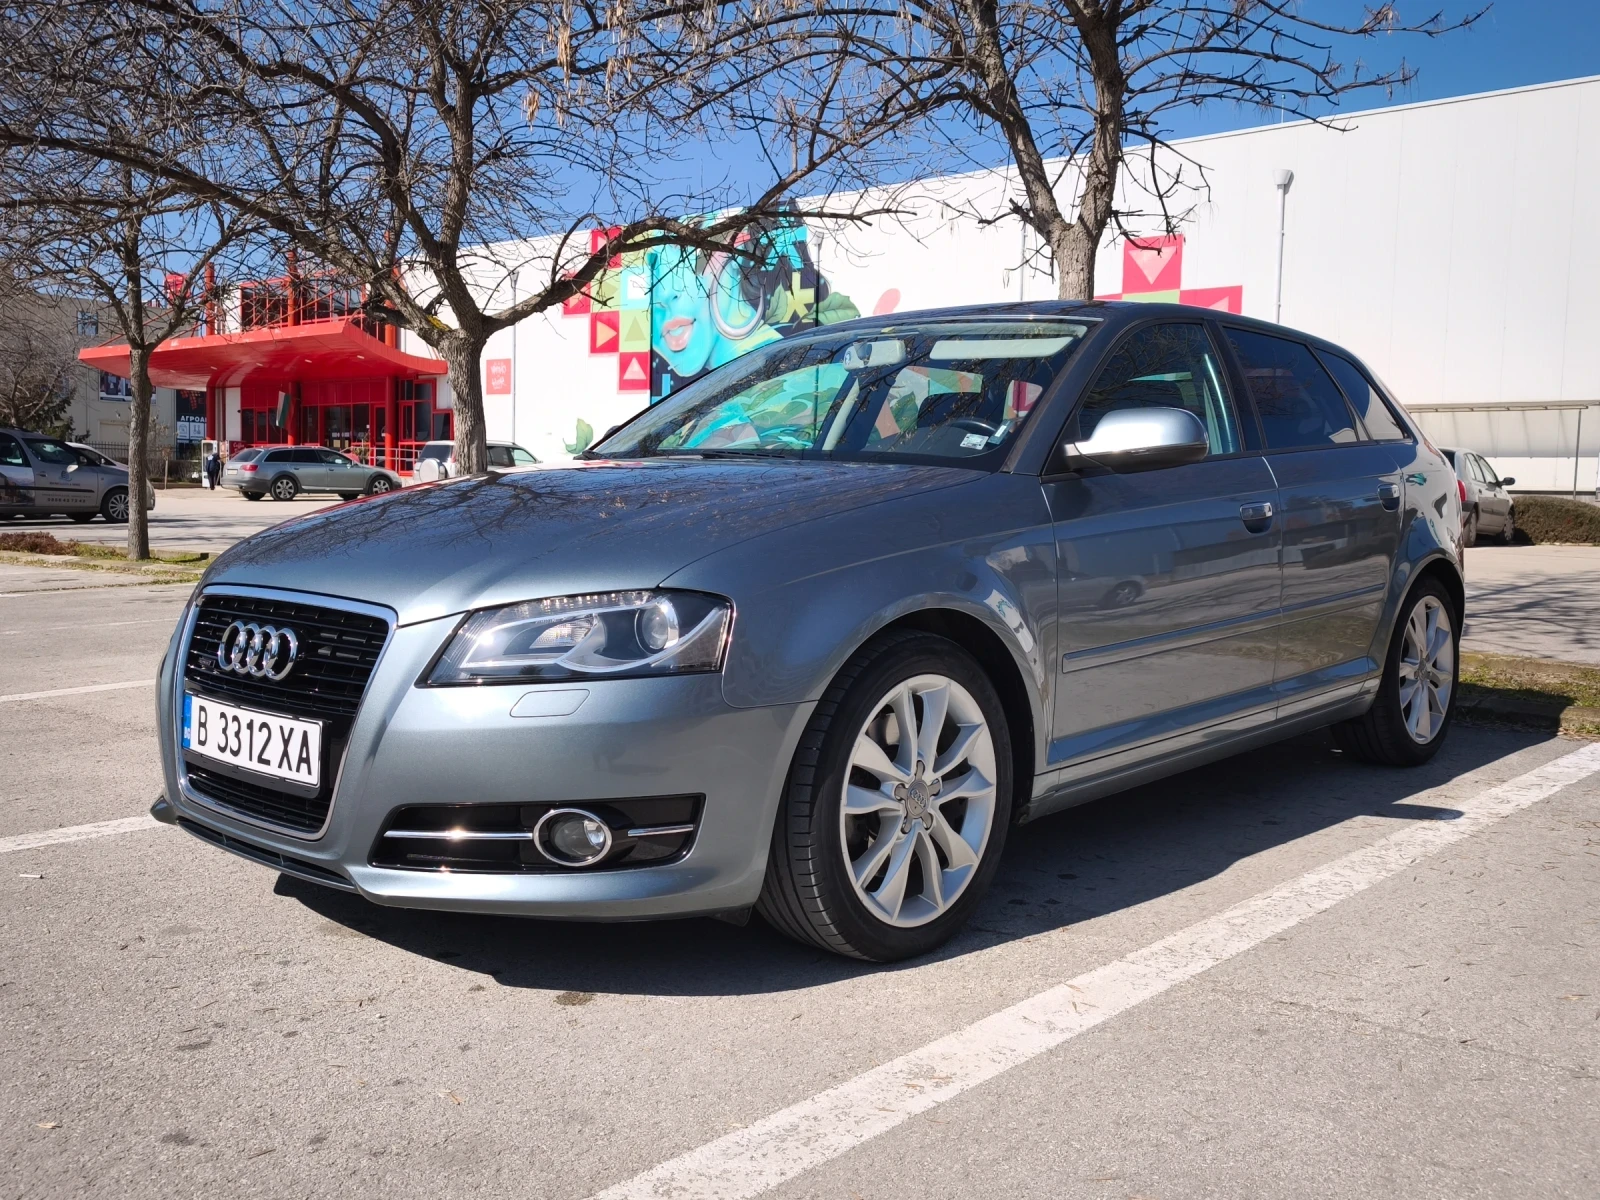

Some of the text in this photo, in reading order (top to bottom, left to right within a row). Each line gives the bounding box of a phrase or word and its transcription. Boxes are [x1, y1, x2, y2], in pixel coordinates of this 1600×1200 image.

[197, 705, 313, 776] B 3312 XA
